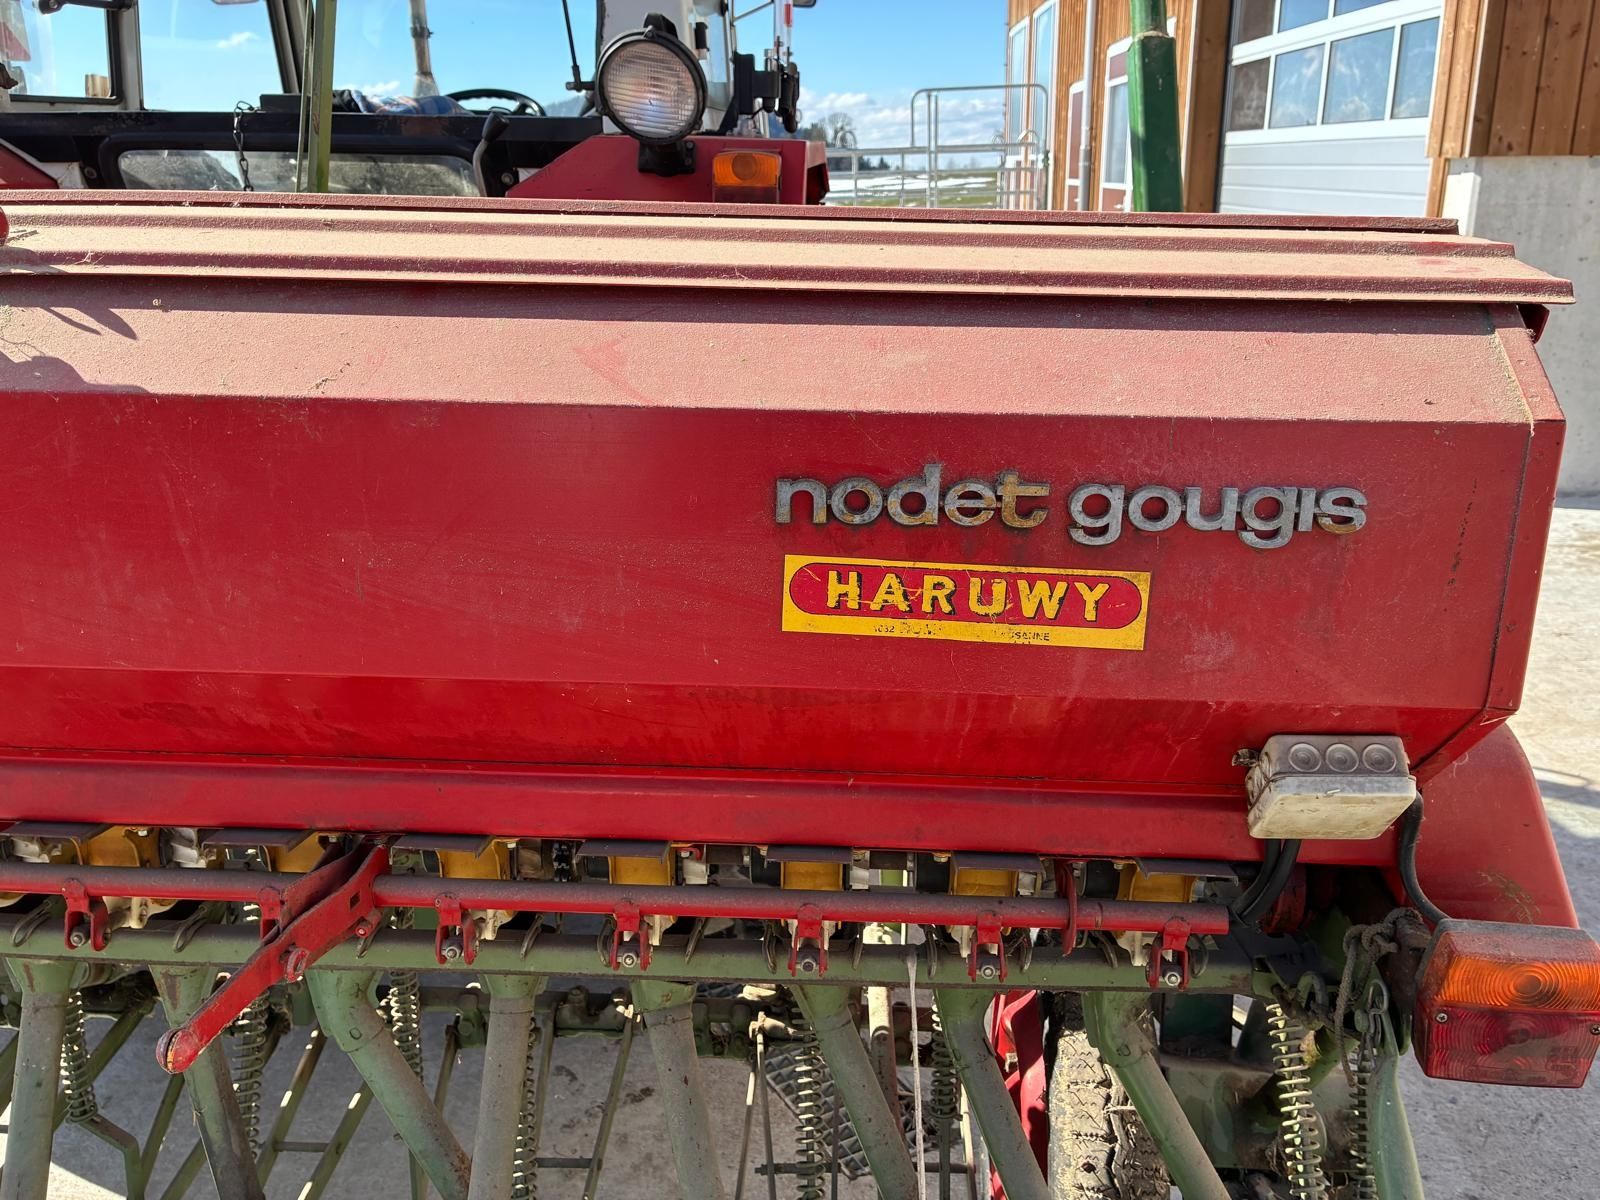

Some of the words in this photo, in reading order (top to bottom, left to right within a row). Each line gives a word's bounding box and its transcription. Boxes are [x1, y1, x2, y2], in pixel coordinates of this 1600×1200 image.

[776, 463, 1050, 529] nodet
[1068, 483, 1368, 549] gougis
[826, 570, 1110, 622] HARUWY
